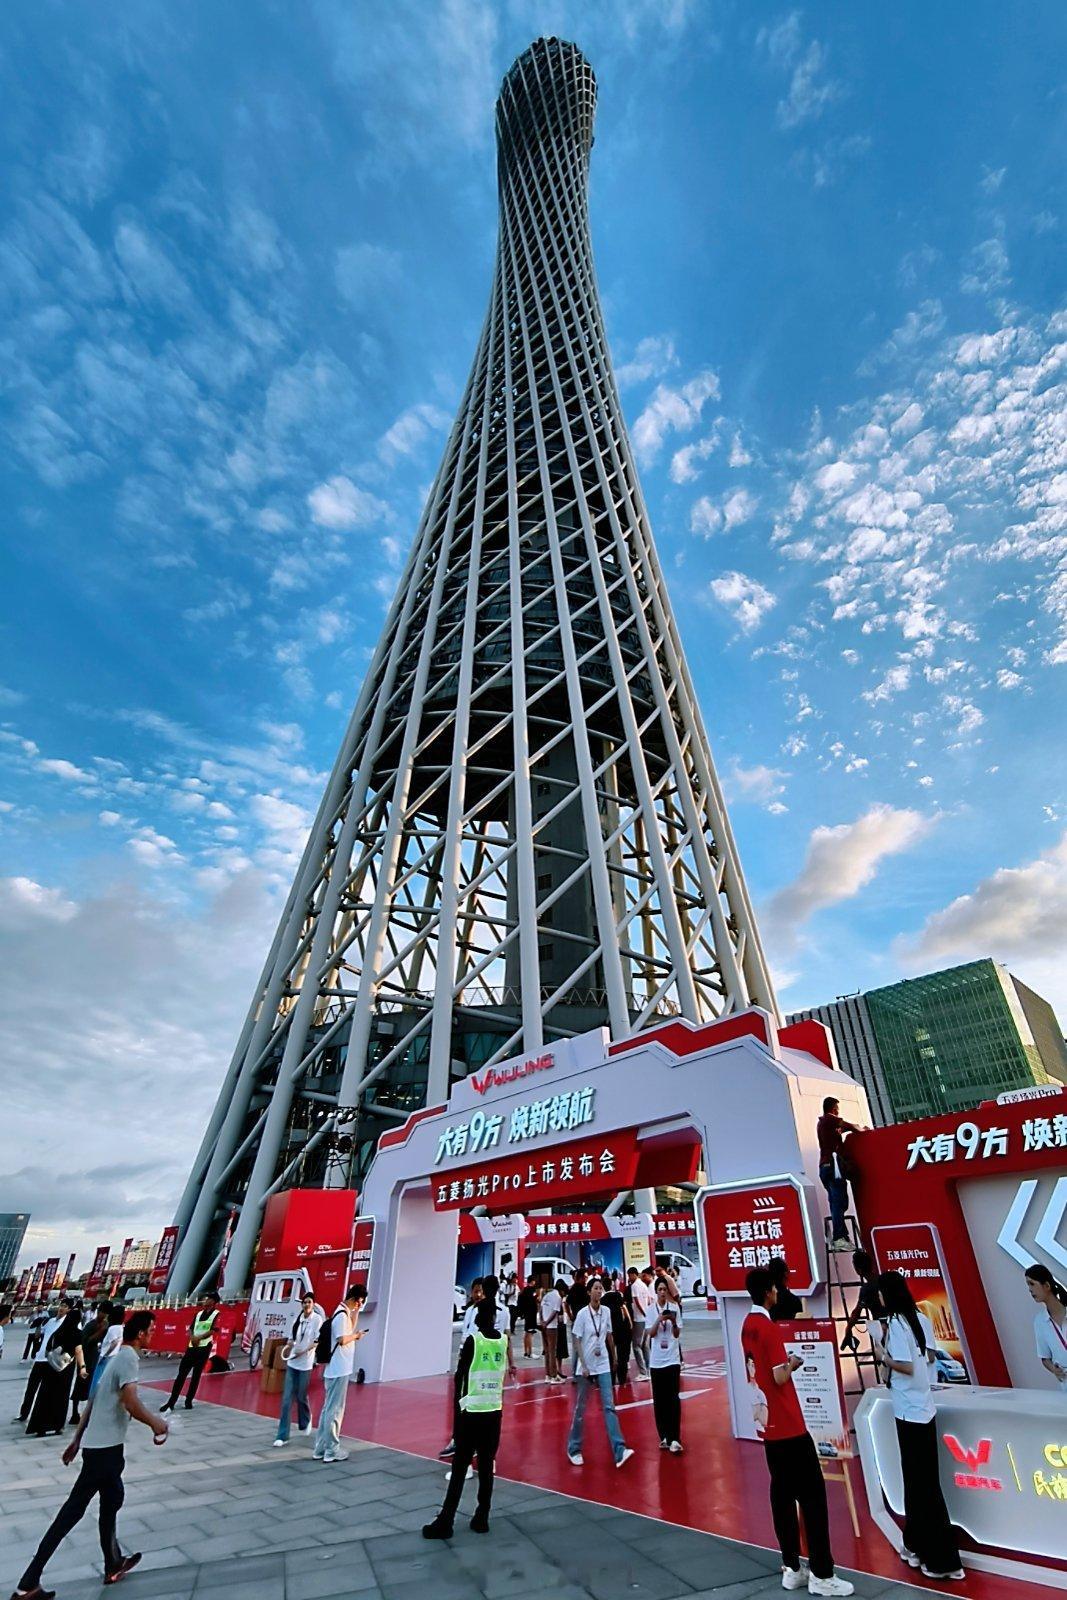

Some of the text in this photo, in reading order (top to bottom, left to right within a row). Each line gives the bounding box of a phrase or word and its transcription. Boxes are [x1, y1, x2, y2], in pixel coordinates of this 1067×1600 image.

[494, 1053, 555, 1086] WULING
[434, 1087, 596, 1165] 大有9方 焕新领航
[906, 1122, 1010, 1170] 大有9方
[437, 1148, 616, 1204] 五菱扬光Pro上市发布会
[725, 1218, 783, 1242] 五菱红标
[728, 1244, 786, 1268] 全面焕新
[886, 1249, 929, 1260] 五菱扬光Pro
